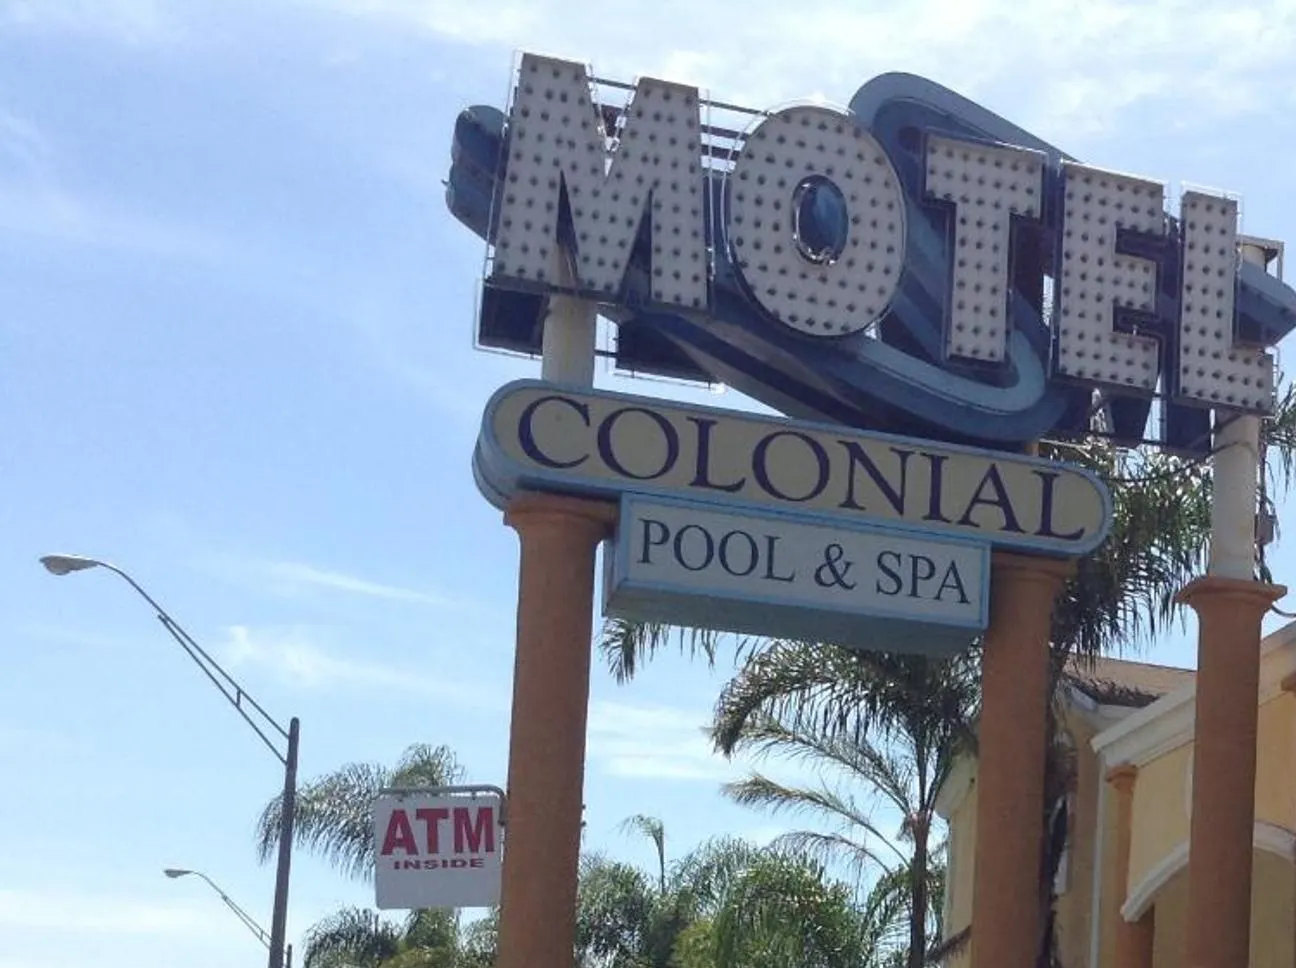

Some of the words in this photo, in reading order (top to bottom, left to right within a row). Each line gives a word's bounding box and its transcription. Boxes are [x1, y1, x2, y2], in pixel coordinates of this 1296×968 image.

[490, 52, 1274, 410] MOTEL
[517, 395, 1086, 541] COLONIAL
[637, 517, 795, 585] POOL
[813, 543, 856, 591] &
[875, 551, 971, 605] SPA
[381, 807, 495, 855] ATM
[394, 859, 485, 869] INSIDE
